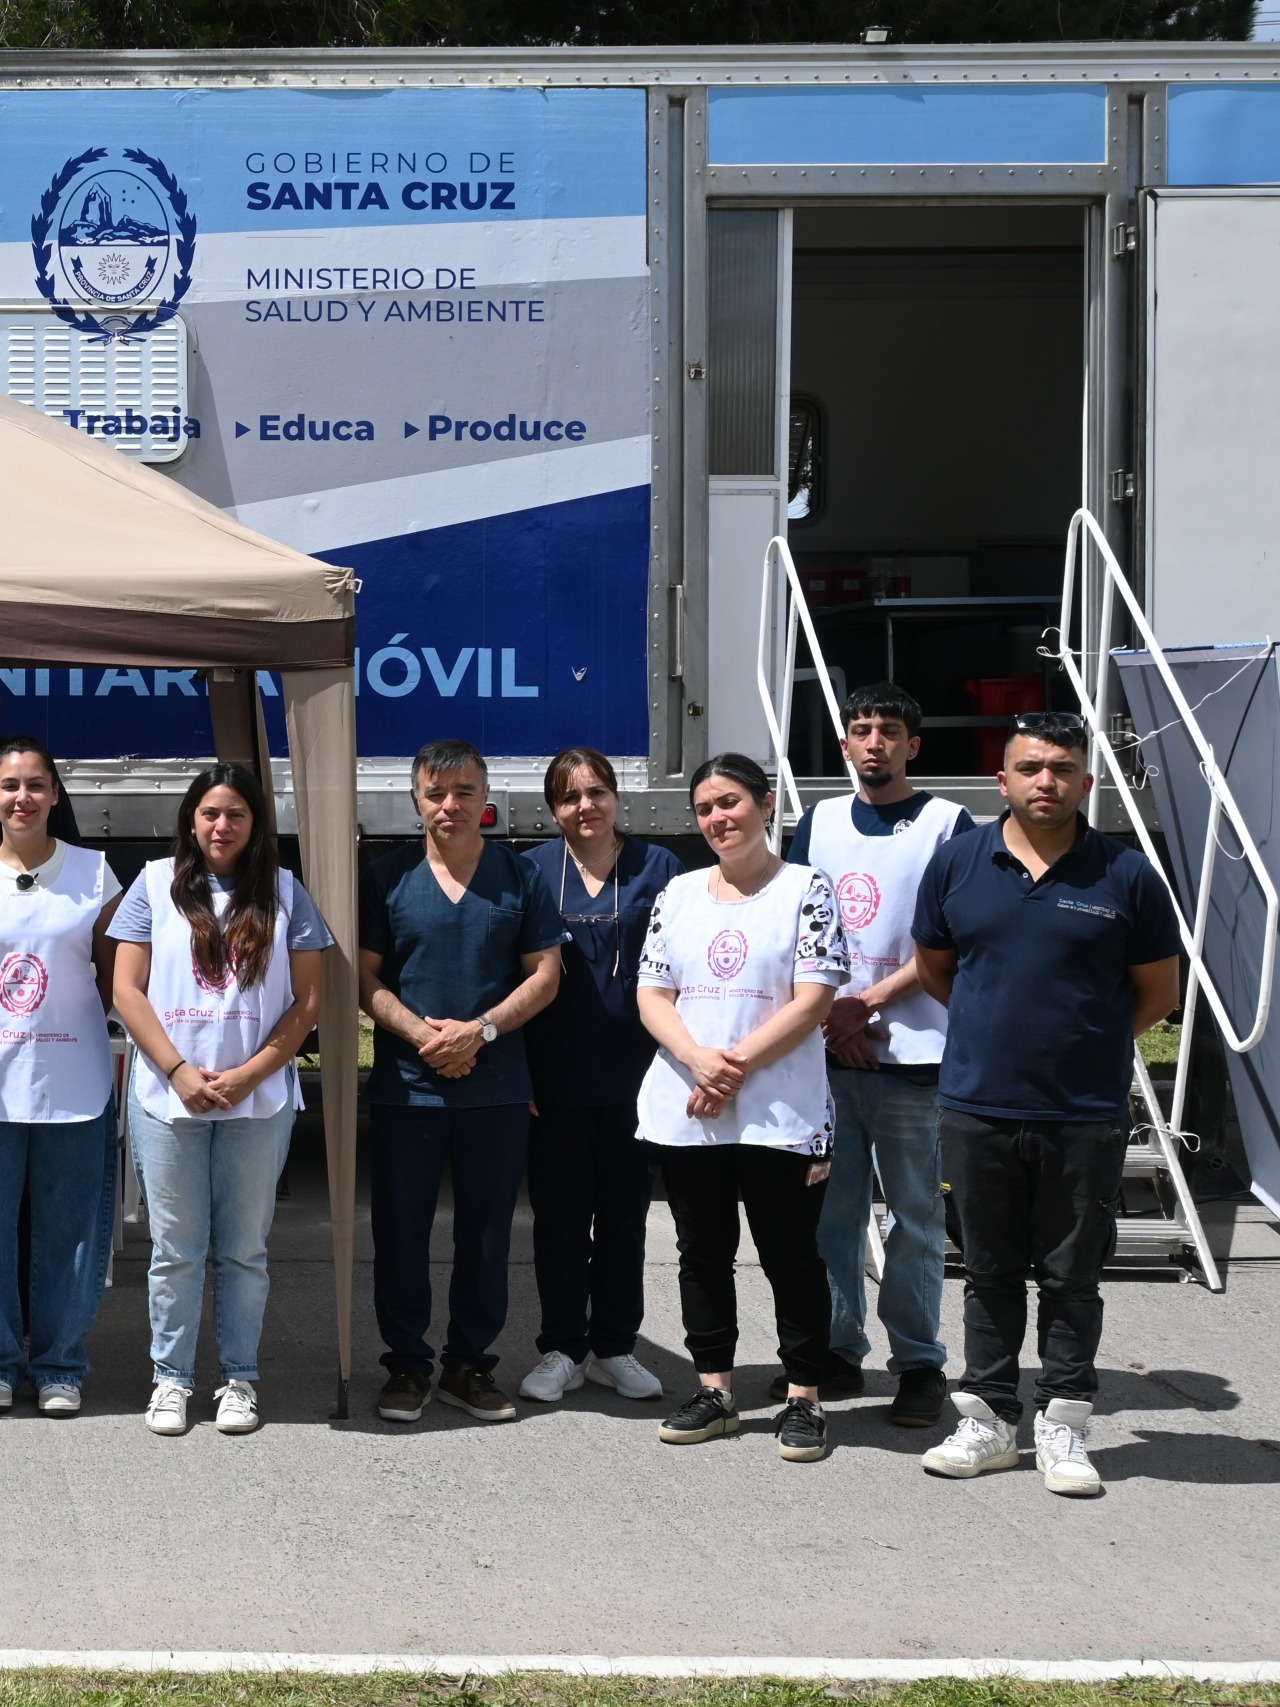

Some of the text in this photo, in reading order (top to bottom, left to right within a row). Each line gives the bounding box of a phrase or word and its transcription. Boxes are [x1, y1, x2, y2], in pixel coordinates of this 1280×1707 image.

[245, 152, 515, 174] GOBIERNO DE
[246, 181, 516, 211] SANTA CRUZ
[74, 271, 105, 300] PROVINCIA
[116, 288, 141, 302] SANTA
[139, 271, 155, 289] CRUZ
[246, 268, 476, 290] MINISTERIO DE
[245, 300, 545, 323] SALUD Y AMBIENTE
[63, 406, 201, 442] Trabaja
[258, 413, 375, 442] Educa
[428, 413, 587, 442] Produce
[355, 632, 539, 698] ÓVIL
[681, 984, 720, 995] nta Cruz
[188, 1007, 214, 1018] Cruz
[2, 1029, 26, 1039] Cruz
